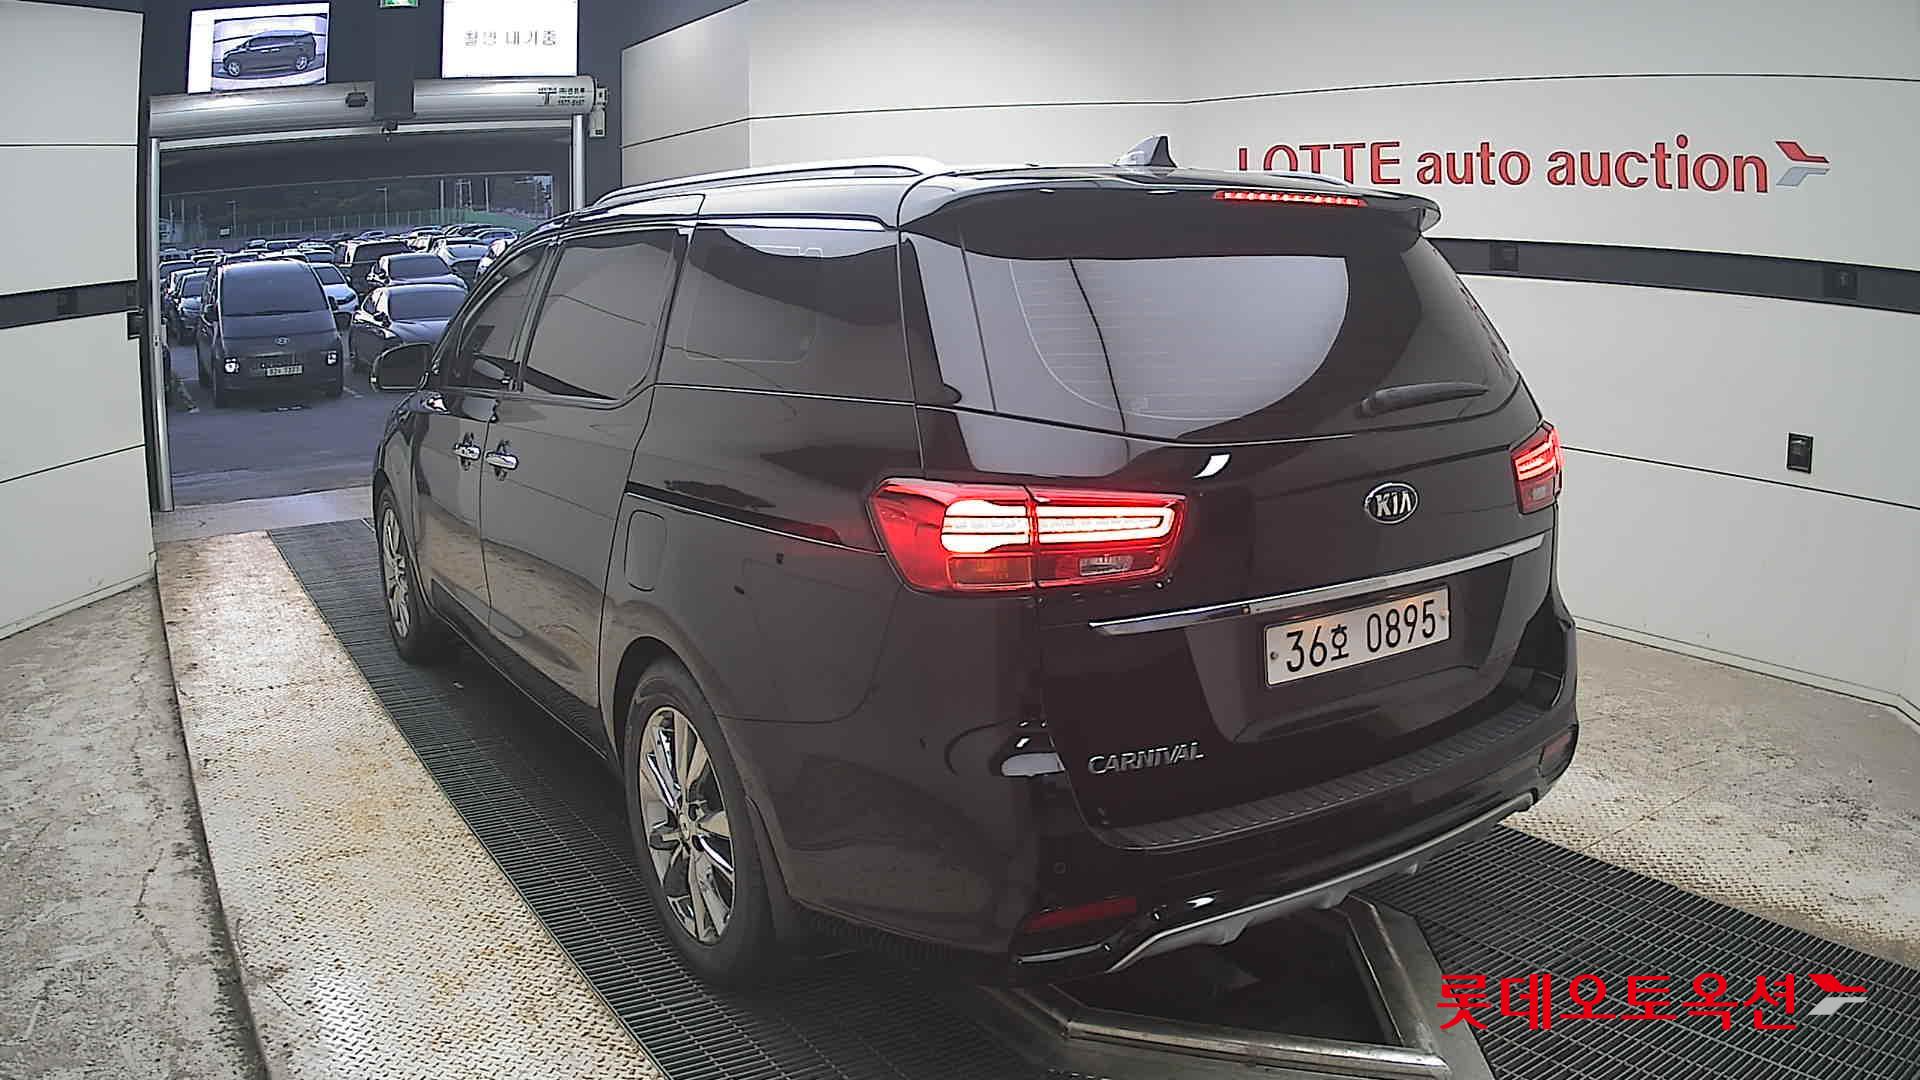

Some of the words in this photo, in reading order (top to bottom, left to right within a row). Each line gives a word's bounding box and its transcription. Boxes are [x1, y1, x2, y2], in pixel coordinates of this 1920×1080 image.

[1416, 141, 1531, 186] auto
[1547, 134, 1769, 193] auction
[1375, 491, 1411, 517] KIA
[1286, 624, 1349, 673] 36호
[1366, 599, 1436, 653] 0895
[1088, 741, 1204, 774] CARNIVAL
